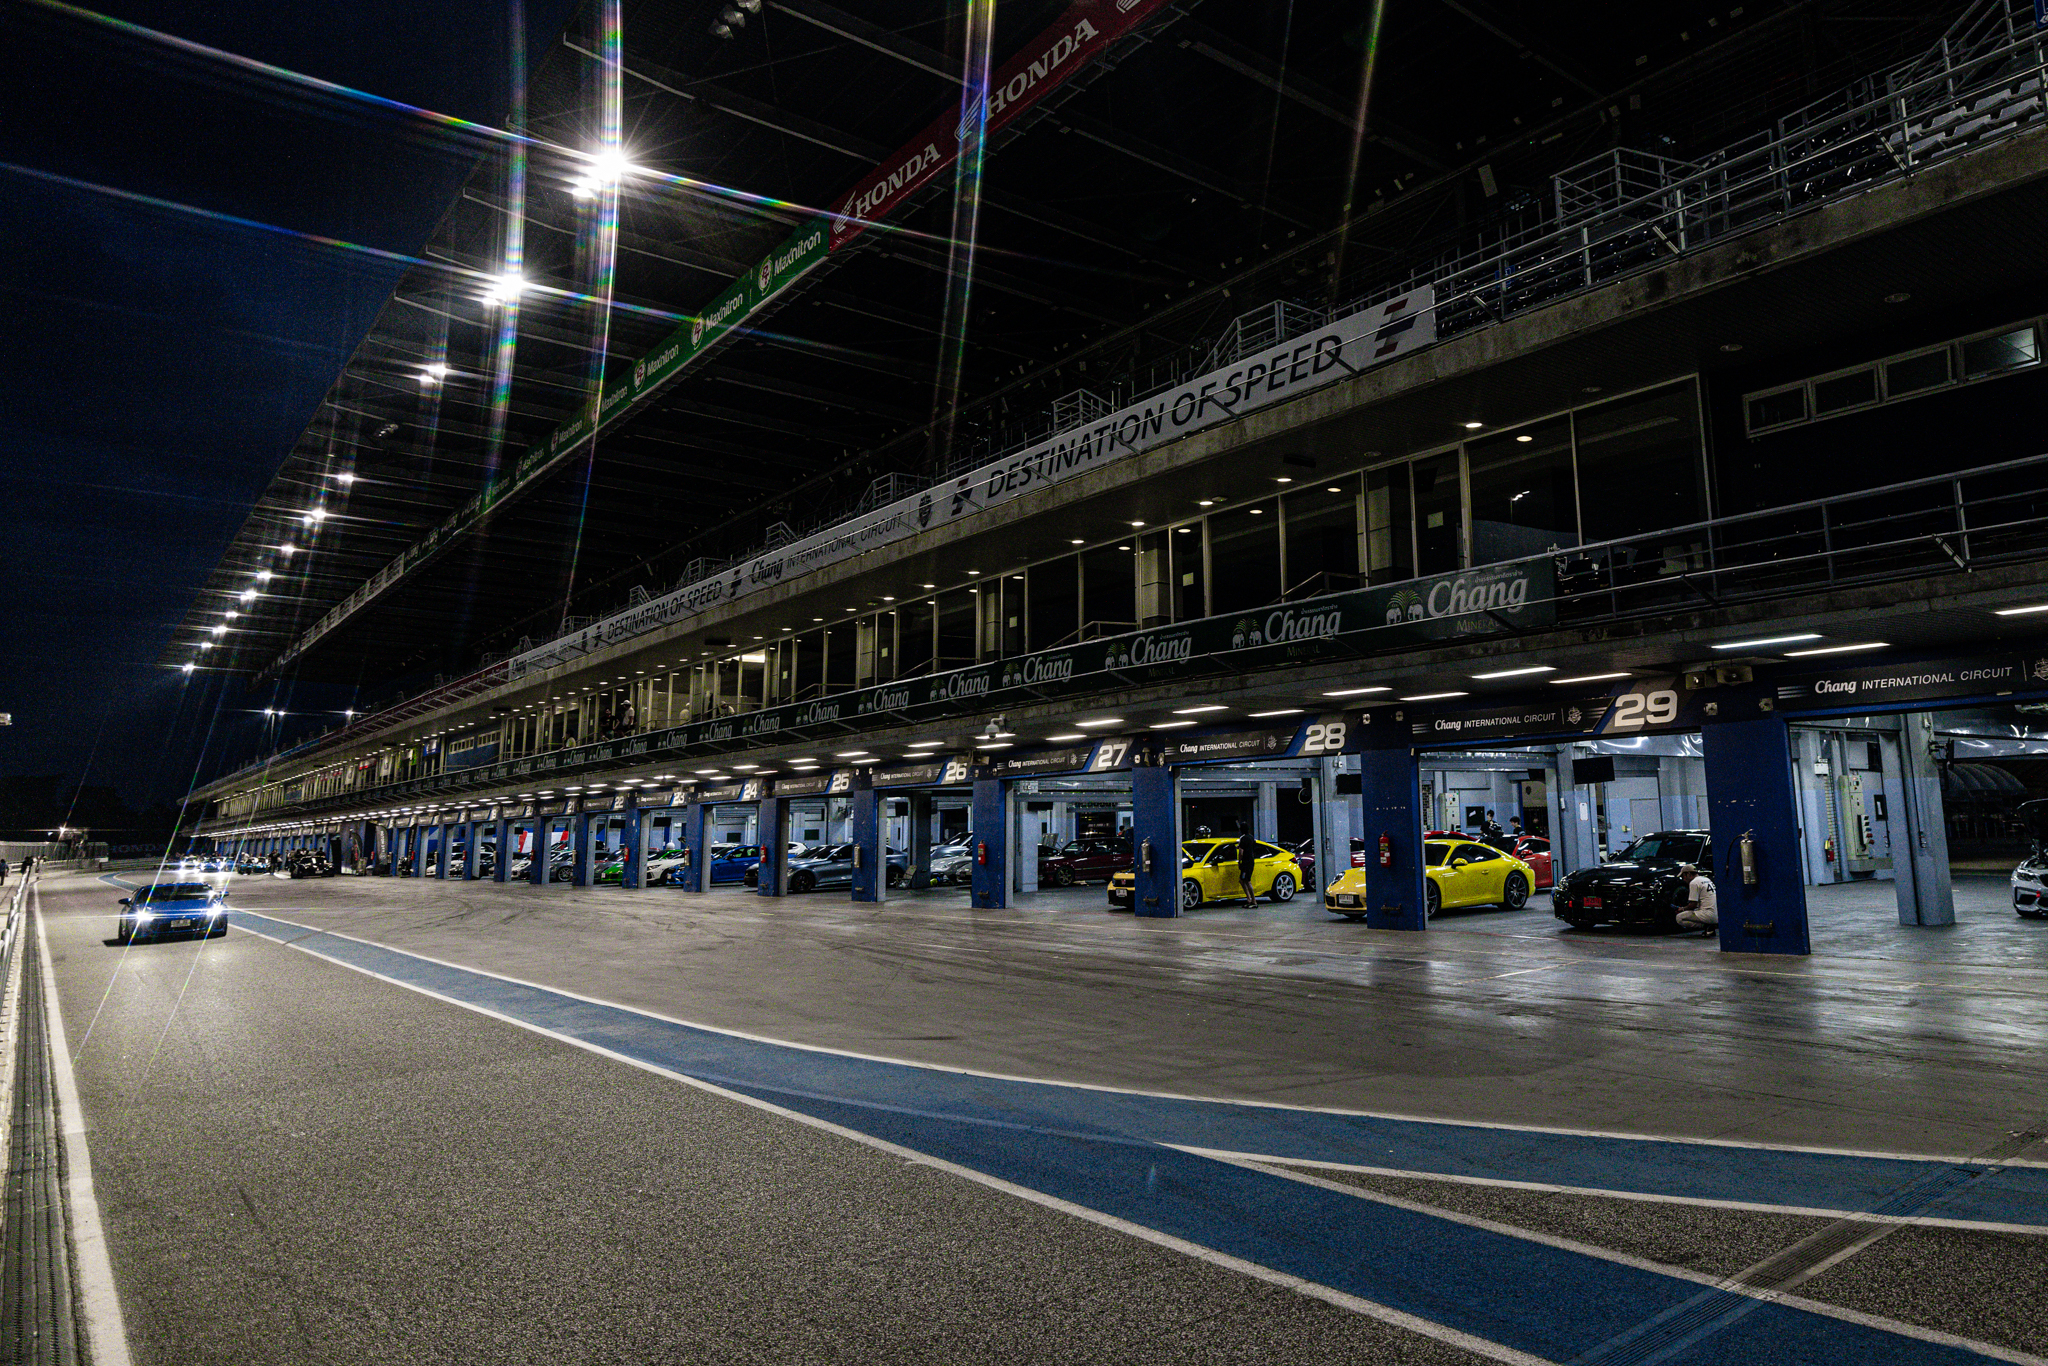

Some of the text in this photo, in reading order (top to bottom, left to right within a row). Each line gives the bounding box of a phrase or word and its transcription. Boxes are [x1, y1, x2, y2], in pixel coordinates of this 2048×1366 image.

[986, 18, 1099, 120] HONDA
[854, 143, 940, 219] HONDA
[988, 334, 1342, 499] DESTINATION OF SPEED
[751, 557, 783, 583] Chang
[860, 511, 904, 541] CIRCUIT
[1427, 577, 1529, 618] Chang
[607, 581, 722, 640] DESTINATION OF SPEED
[1264, 609, 1342, 644] Chang
[1130, 635, 1192, 665] Chang
[1023, 655, 1074, 684] Chang
[1815, 666, 2013, 695] Chang INTERNATIONAL CIRCUIT
[947, 673, 990, 698] Chang
[874, 688, 909, 711] Chang
[1614, 689, 1678, 728] 29
[753, 714, 780, 733] Chang
[808, 702, 840, 723] Chang
[1434, 712, 1556, 732] Chang INTERNATIONAL CIRCUIT
[666, 730, 688, 748] Chang
[709, 722, 733, 739] Chang
[1304, 722, 1346, 752] 28
[1097, 743, 1127, 767] 27
[1179, 739, 1260, 754] Chang INTERNATIONAL CIRCUIT
[945, 761, 967, 781] 26
[1008, 758, 1022, 769] Chang
[1022, 757, 1049, 767] INTERNATIONAL
[832, 772, 850, 791] 25
[880, 772, 891, 781] Chang
[674, 791, 685, 804] 23
[743, 782, 758, 799] 24
[614, 796, 624, 809] 22
